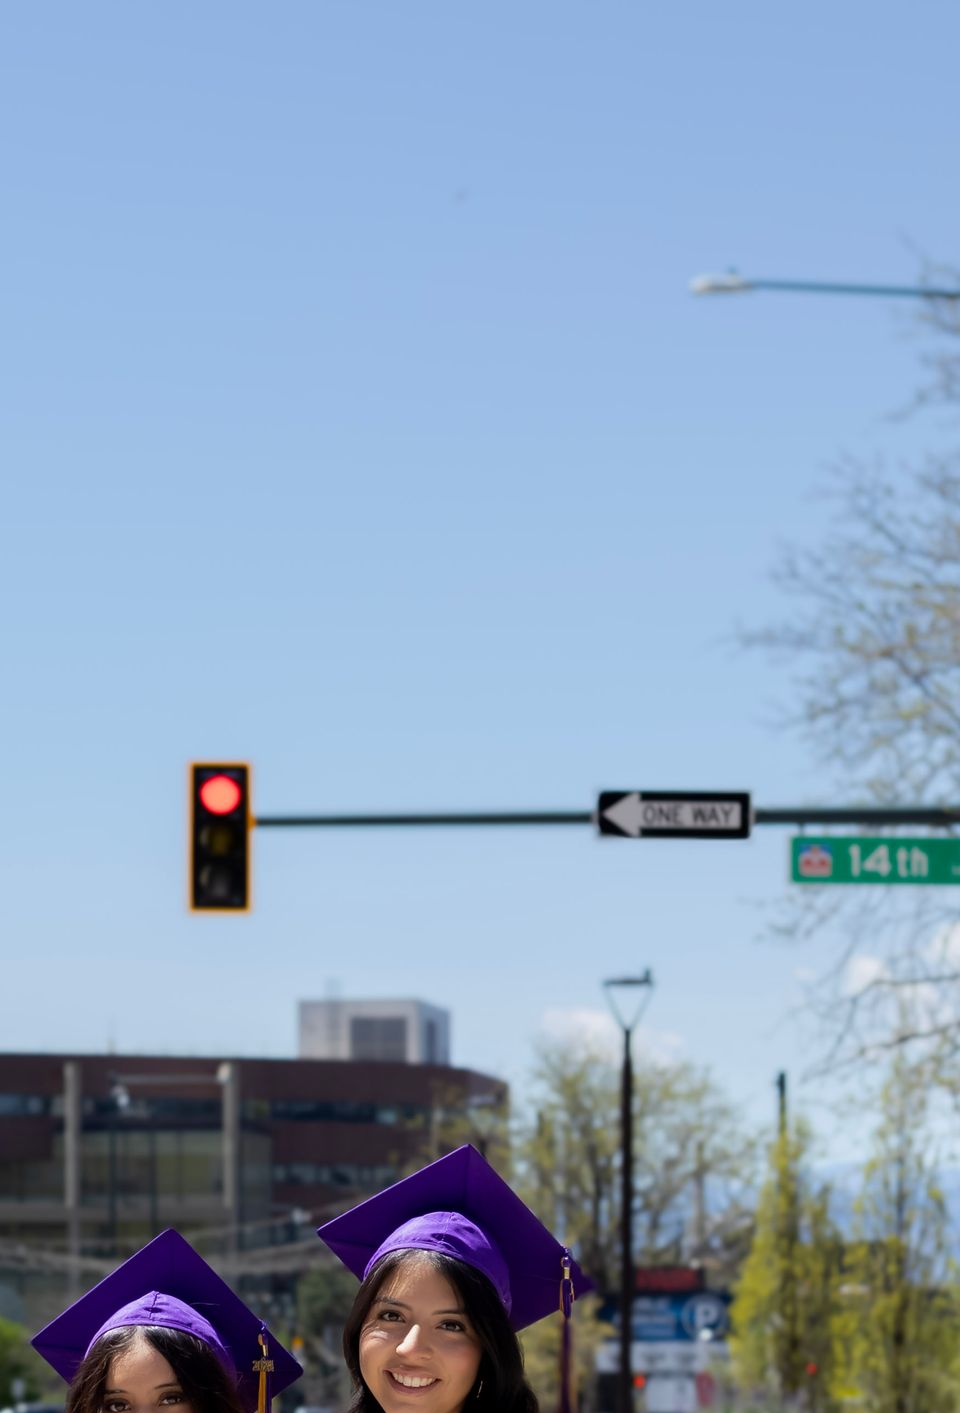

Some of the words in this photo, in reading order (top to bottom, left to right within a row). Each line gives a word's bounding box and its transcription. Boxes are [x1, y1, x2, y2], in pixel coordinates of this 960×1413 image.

[642, 803, 683, 825] ONE
[691, 803, 735, 824] WAY
[848, 844, 928, 877] 14th
[695, 1302, 719, 1335] P
